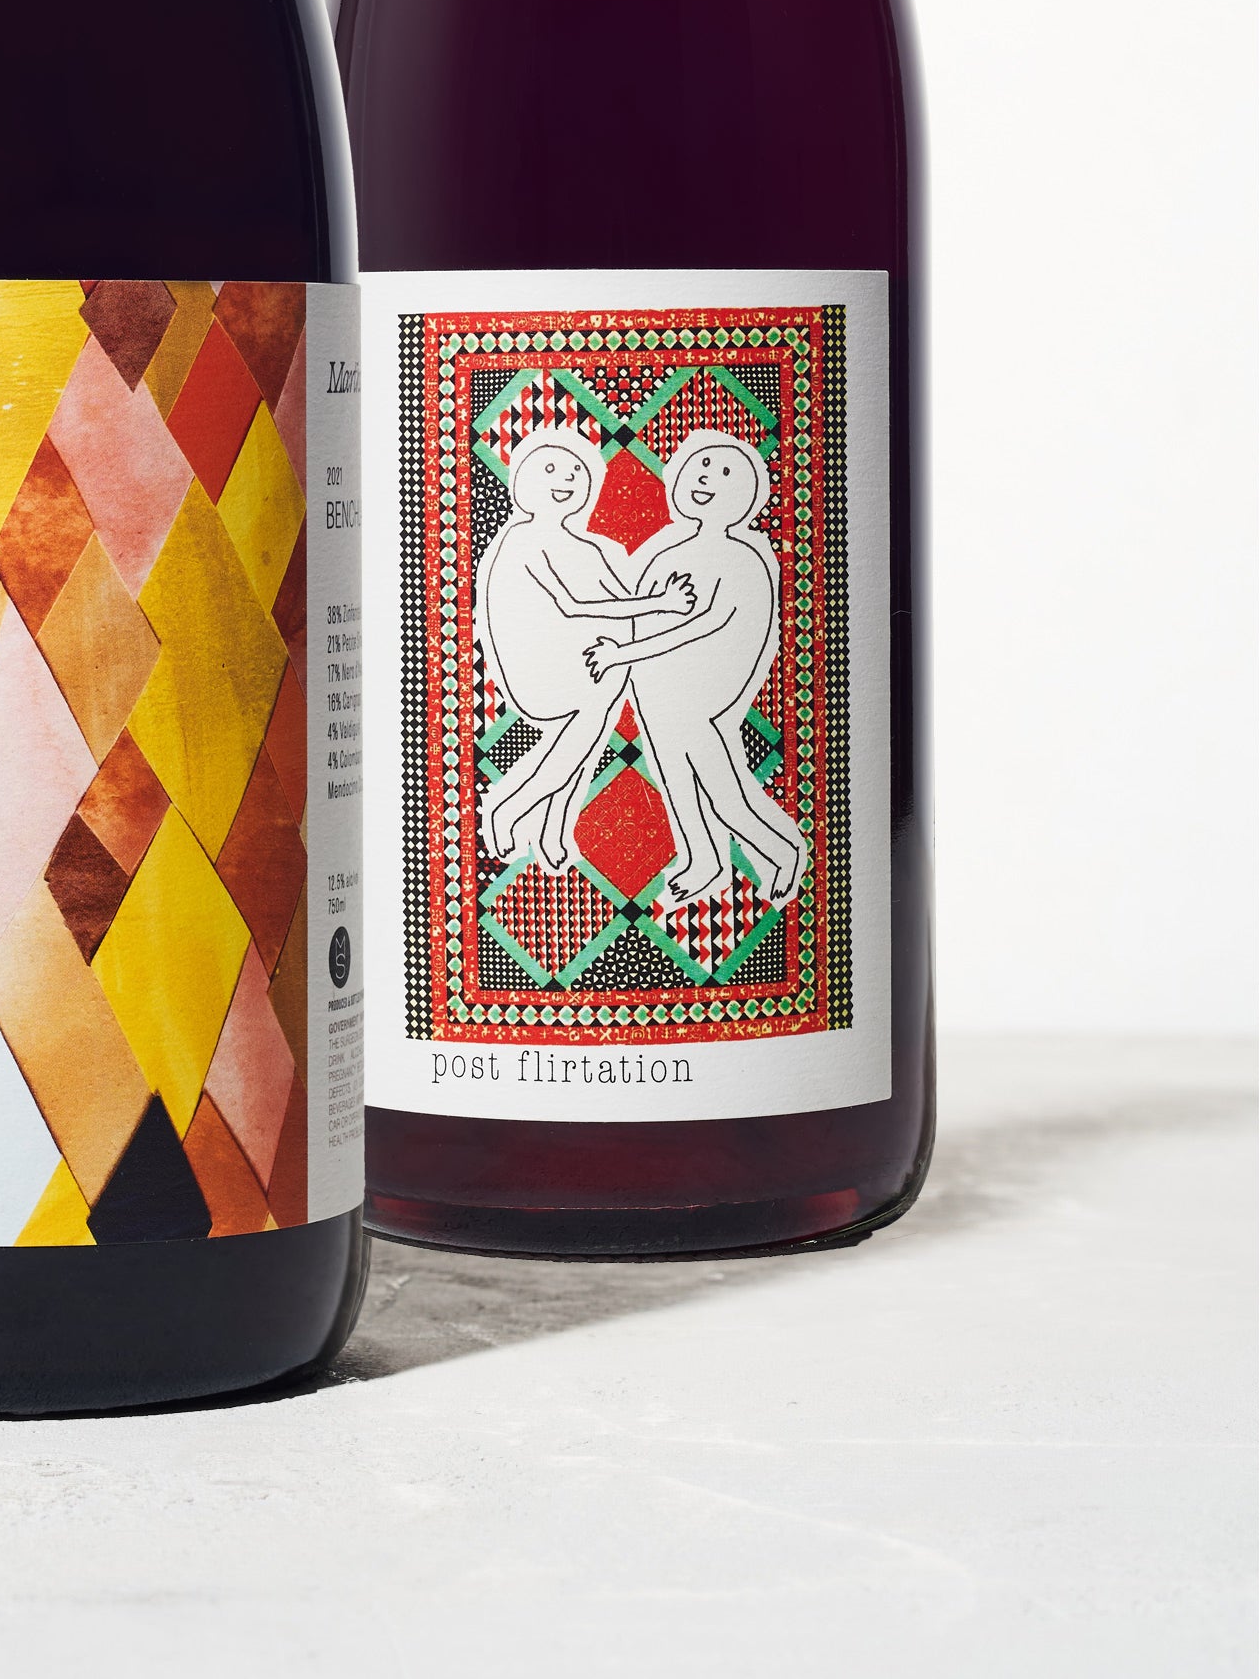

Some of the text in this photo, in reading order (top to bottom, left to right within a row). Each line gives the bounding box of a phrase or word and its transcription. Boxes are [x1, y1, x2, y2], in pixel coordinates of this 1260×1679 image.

[326, 466, 343, 486] 2021
[327, 605, 342, 624] 38%
[327, 634, 341, 654] 21%
[327, 663, 341, 683] 17%
[327, 692, 341, 712] 16%
[327, 722, 339, 741] 4%
[327, 751, 339, 770] 4%
[328, 872, 345, 892] 12.5%
[431, 1050, 693, 1084] post flirtation
